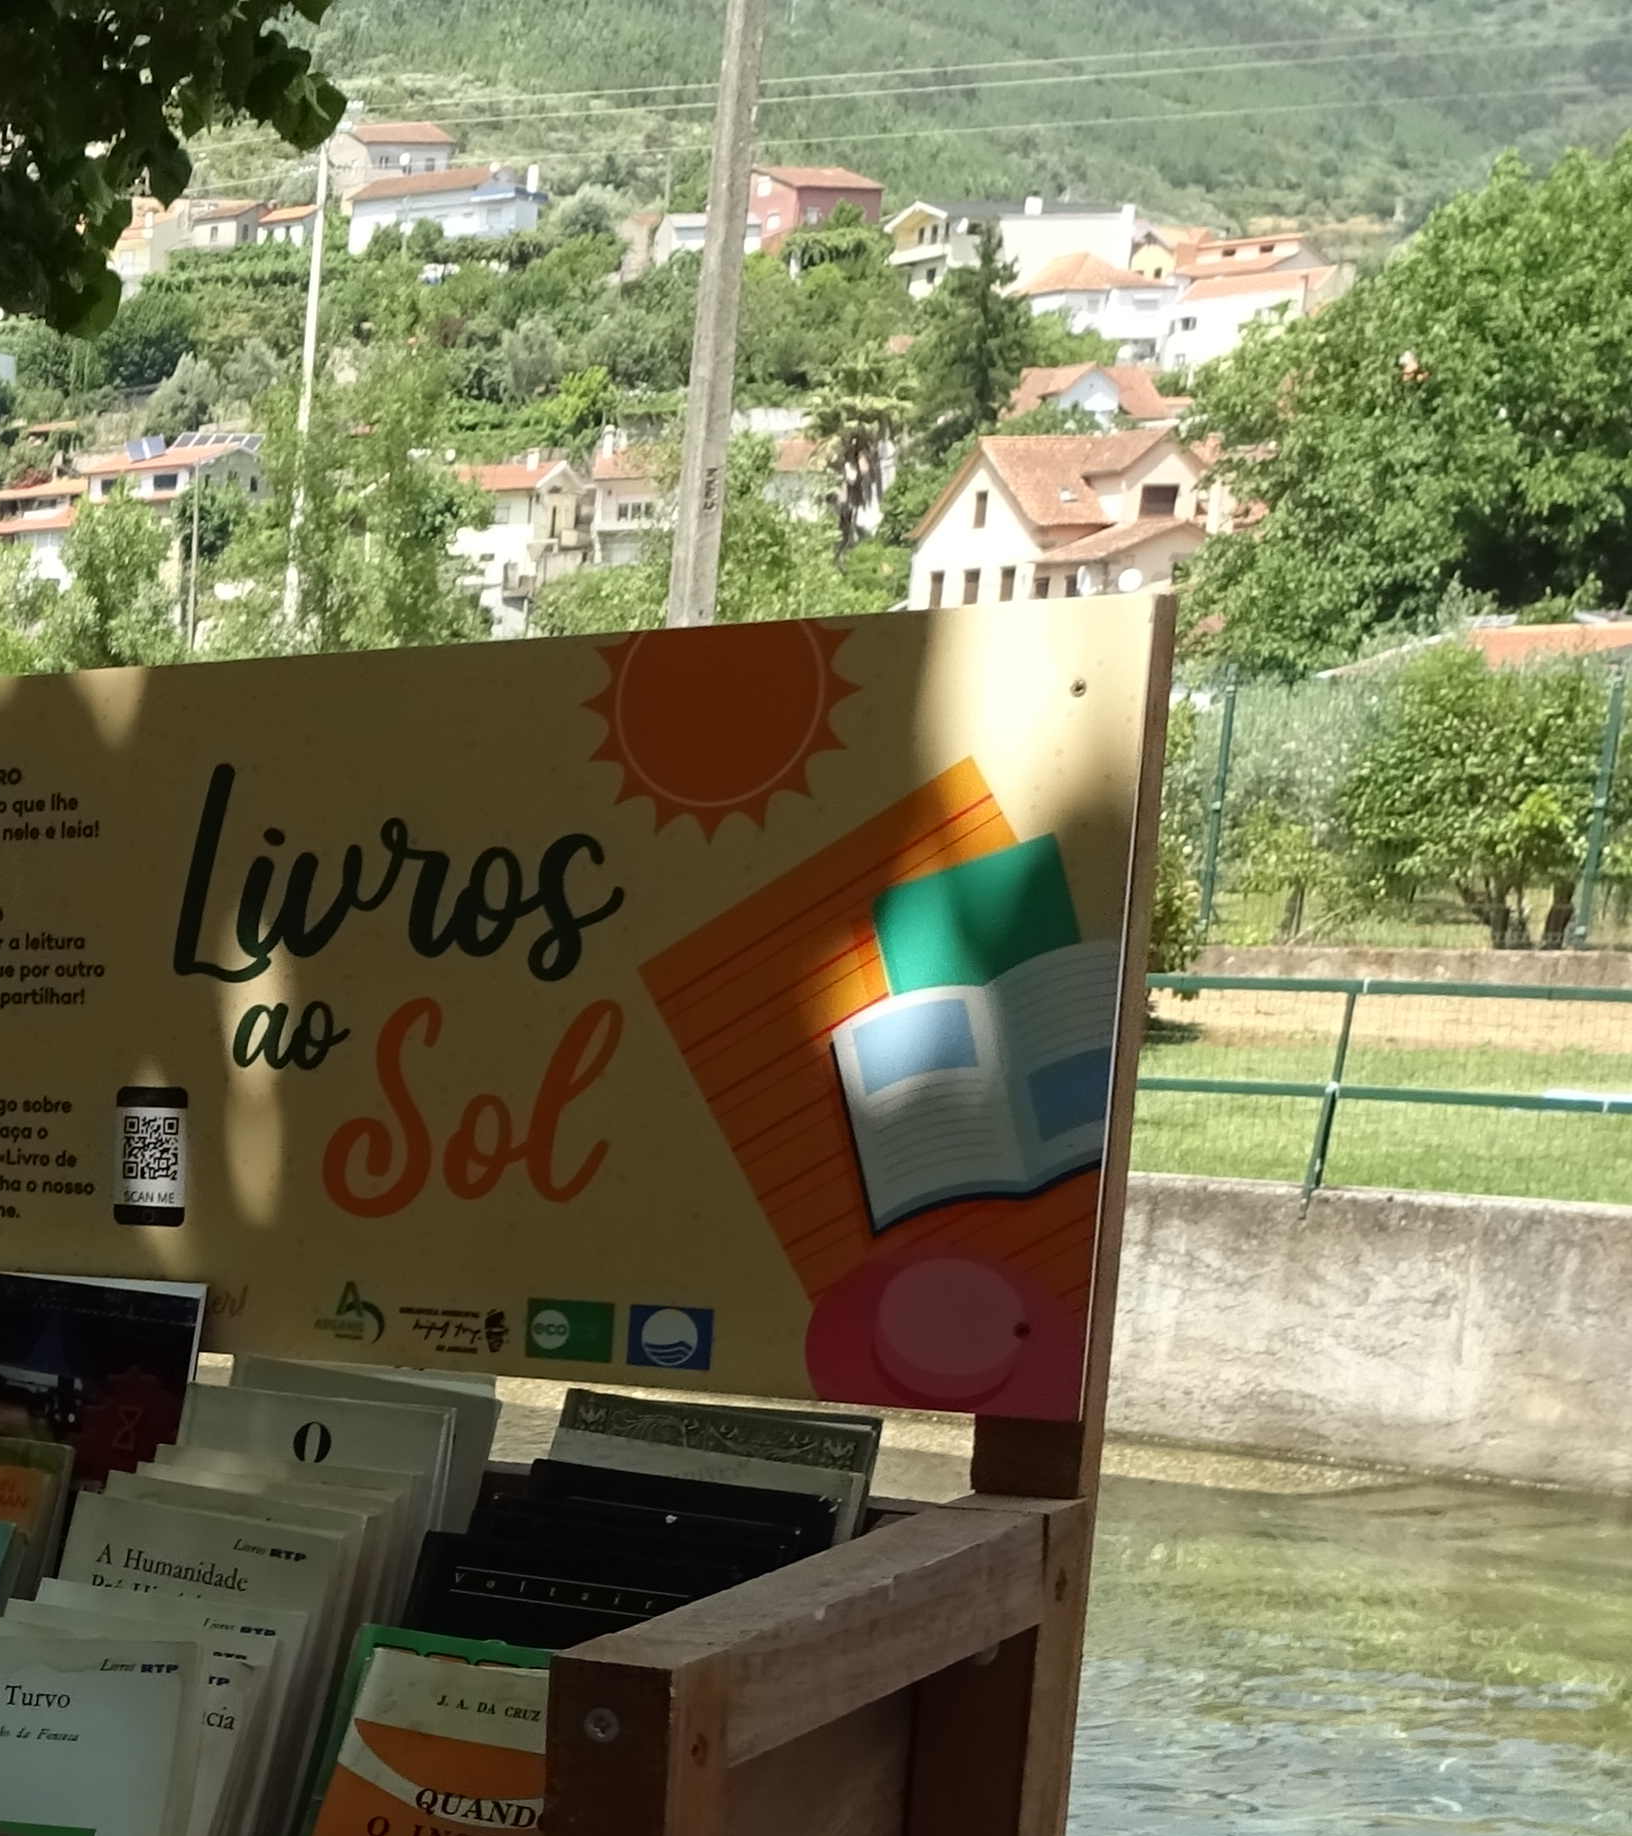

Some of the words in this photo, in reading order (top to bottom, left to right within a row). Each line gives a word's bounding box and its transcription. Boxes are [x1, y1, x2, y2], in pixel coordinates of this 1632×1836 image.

[11, 797, 45, 821] que
[50, 794, 79, 812] lhe
[2, 822, 39, 842] nele
[44, 827, 55, 840] e
[60, 820, 99, 840] leia!
[173, 764, 625, 984] Livros
[10, 936, 21, 950] a
[25, 933, 85, 951] leitura
[19, 962, 49, 982] por
[54, 960, 105, 979] outro
[233, 999, 351, 1071] ao
[22, 1096, 72, 1114] sobre
[322, 997, 625, 1219] Sol
[37, 1126, 49, 1140] o
[56, 1149, 78, 1168] de
[26, 1179, 37, 1193] o
[41, 1180, 94, 1197] nosso
[123, 1190, 152, 1204] SCAN
[155, 1191, 176, 1204] ME
[532, 1321, 569, 1336] eco
[293, 1421, 332, 1464] O
[269, 1547, 307, 1561] RTP
[96, 1543, 113, 1565] A
[123, 1548, 249, 1592] Humanidade
[140, 1662, 179, 1674] RTP
[5, 1683, 71, 1710] Turvo
[436, 1693, 450, 1708] J.
[456, 1699, 470, 1711] A.
[477, 1700, 496, 1716] DA
[504, 1705, 542, 1722] CRUZ
[415, 1786, 543, 1829] QUAND
